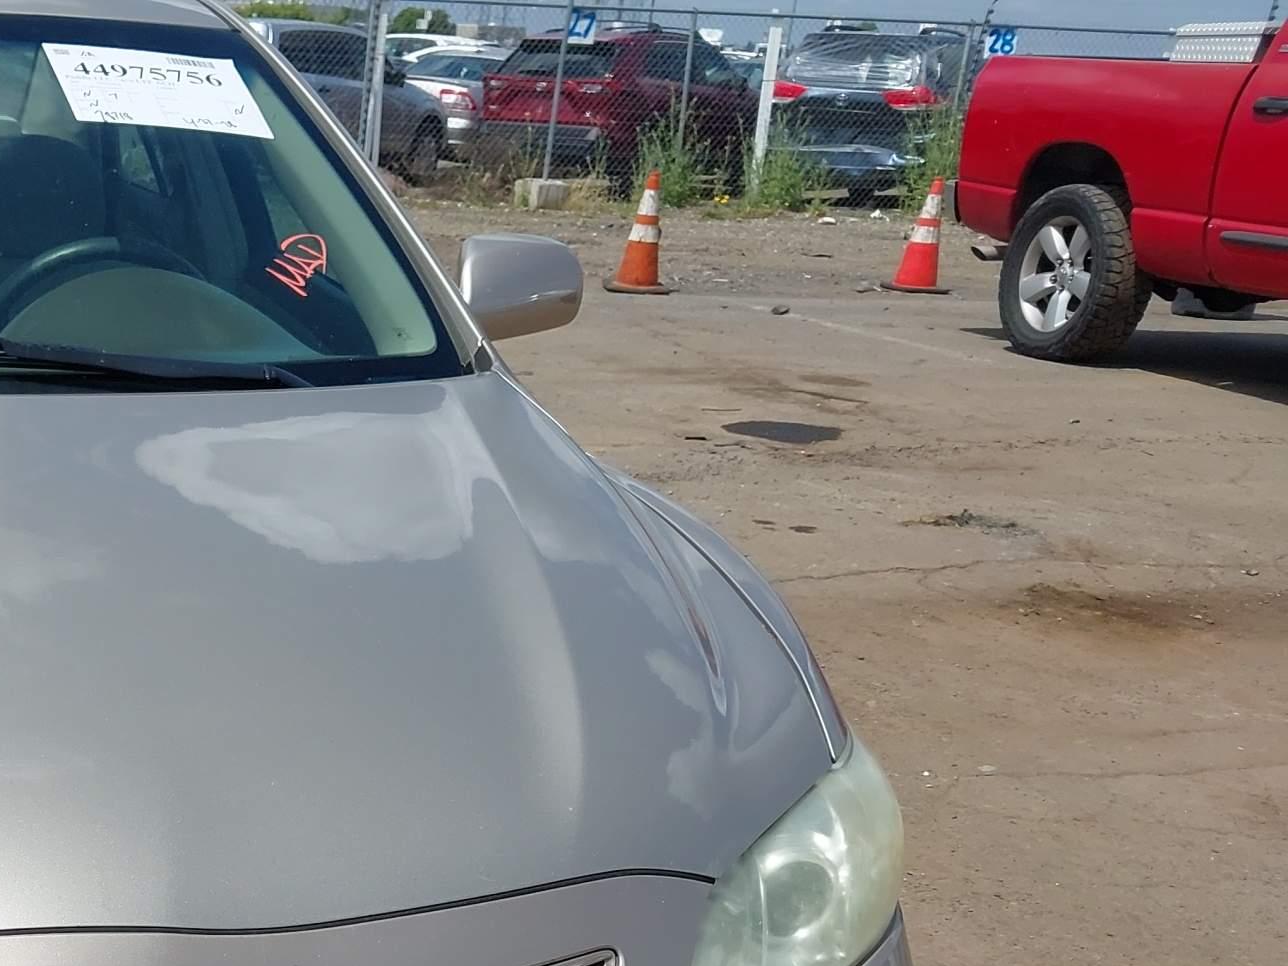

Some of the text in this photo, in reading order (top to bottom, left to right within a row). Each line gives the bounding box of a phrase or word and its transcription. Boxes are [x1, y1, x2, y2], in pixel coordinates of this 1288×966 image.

[569, 7, 597, 39] 27
[988, 23, 1016, 55] 28
[73, 61, 224, 87] 44975756
